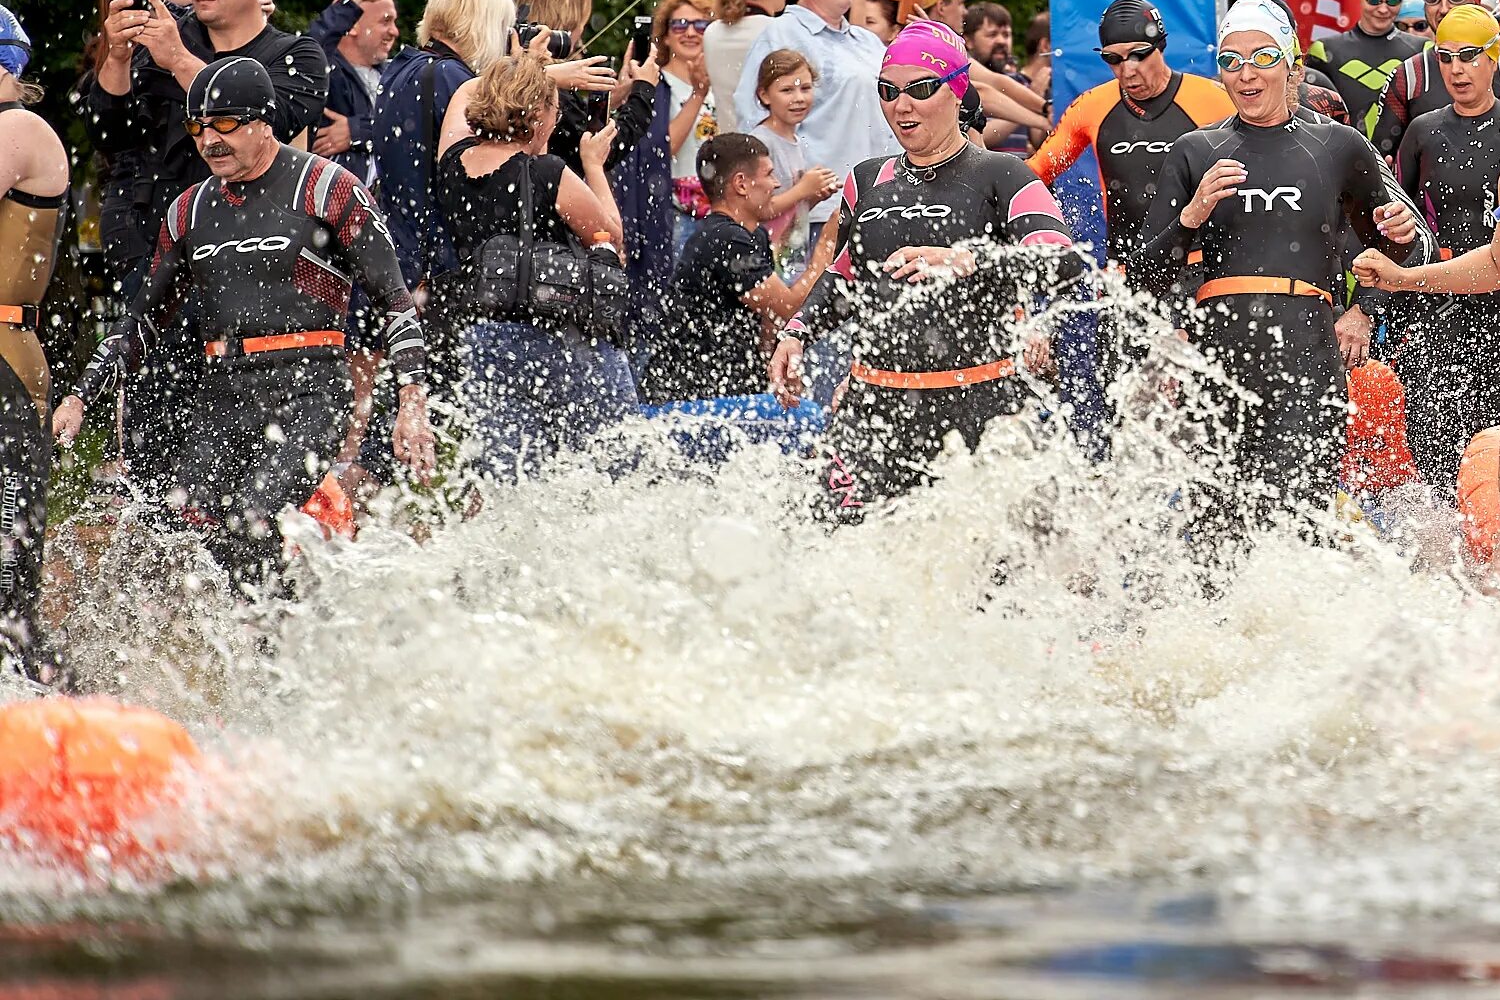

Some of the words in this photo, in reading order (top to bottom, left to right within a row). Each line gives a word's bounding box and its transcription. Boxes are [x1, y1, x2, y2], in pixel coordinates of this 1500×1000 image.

[920, 51, 948, 70] TYR
[1284, 119, 1300, 133] TYR
[1238, 186, 1302, 213] TYR
[857, 203, 952, 223] orca
[192, 235, 291, 261] orca
